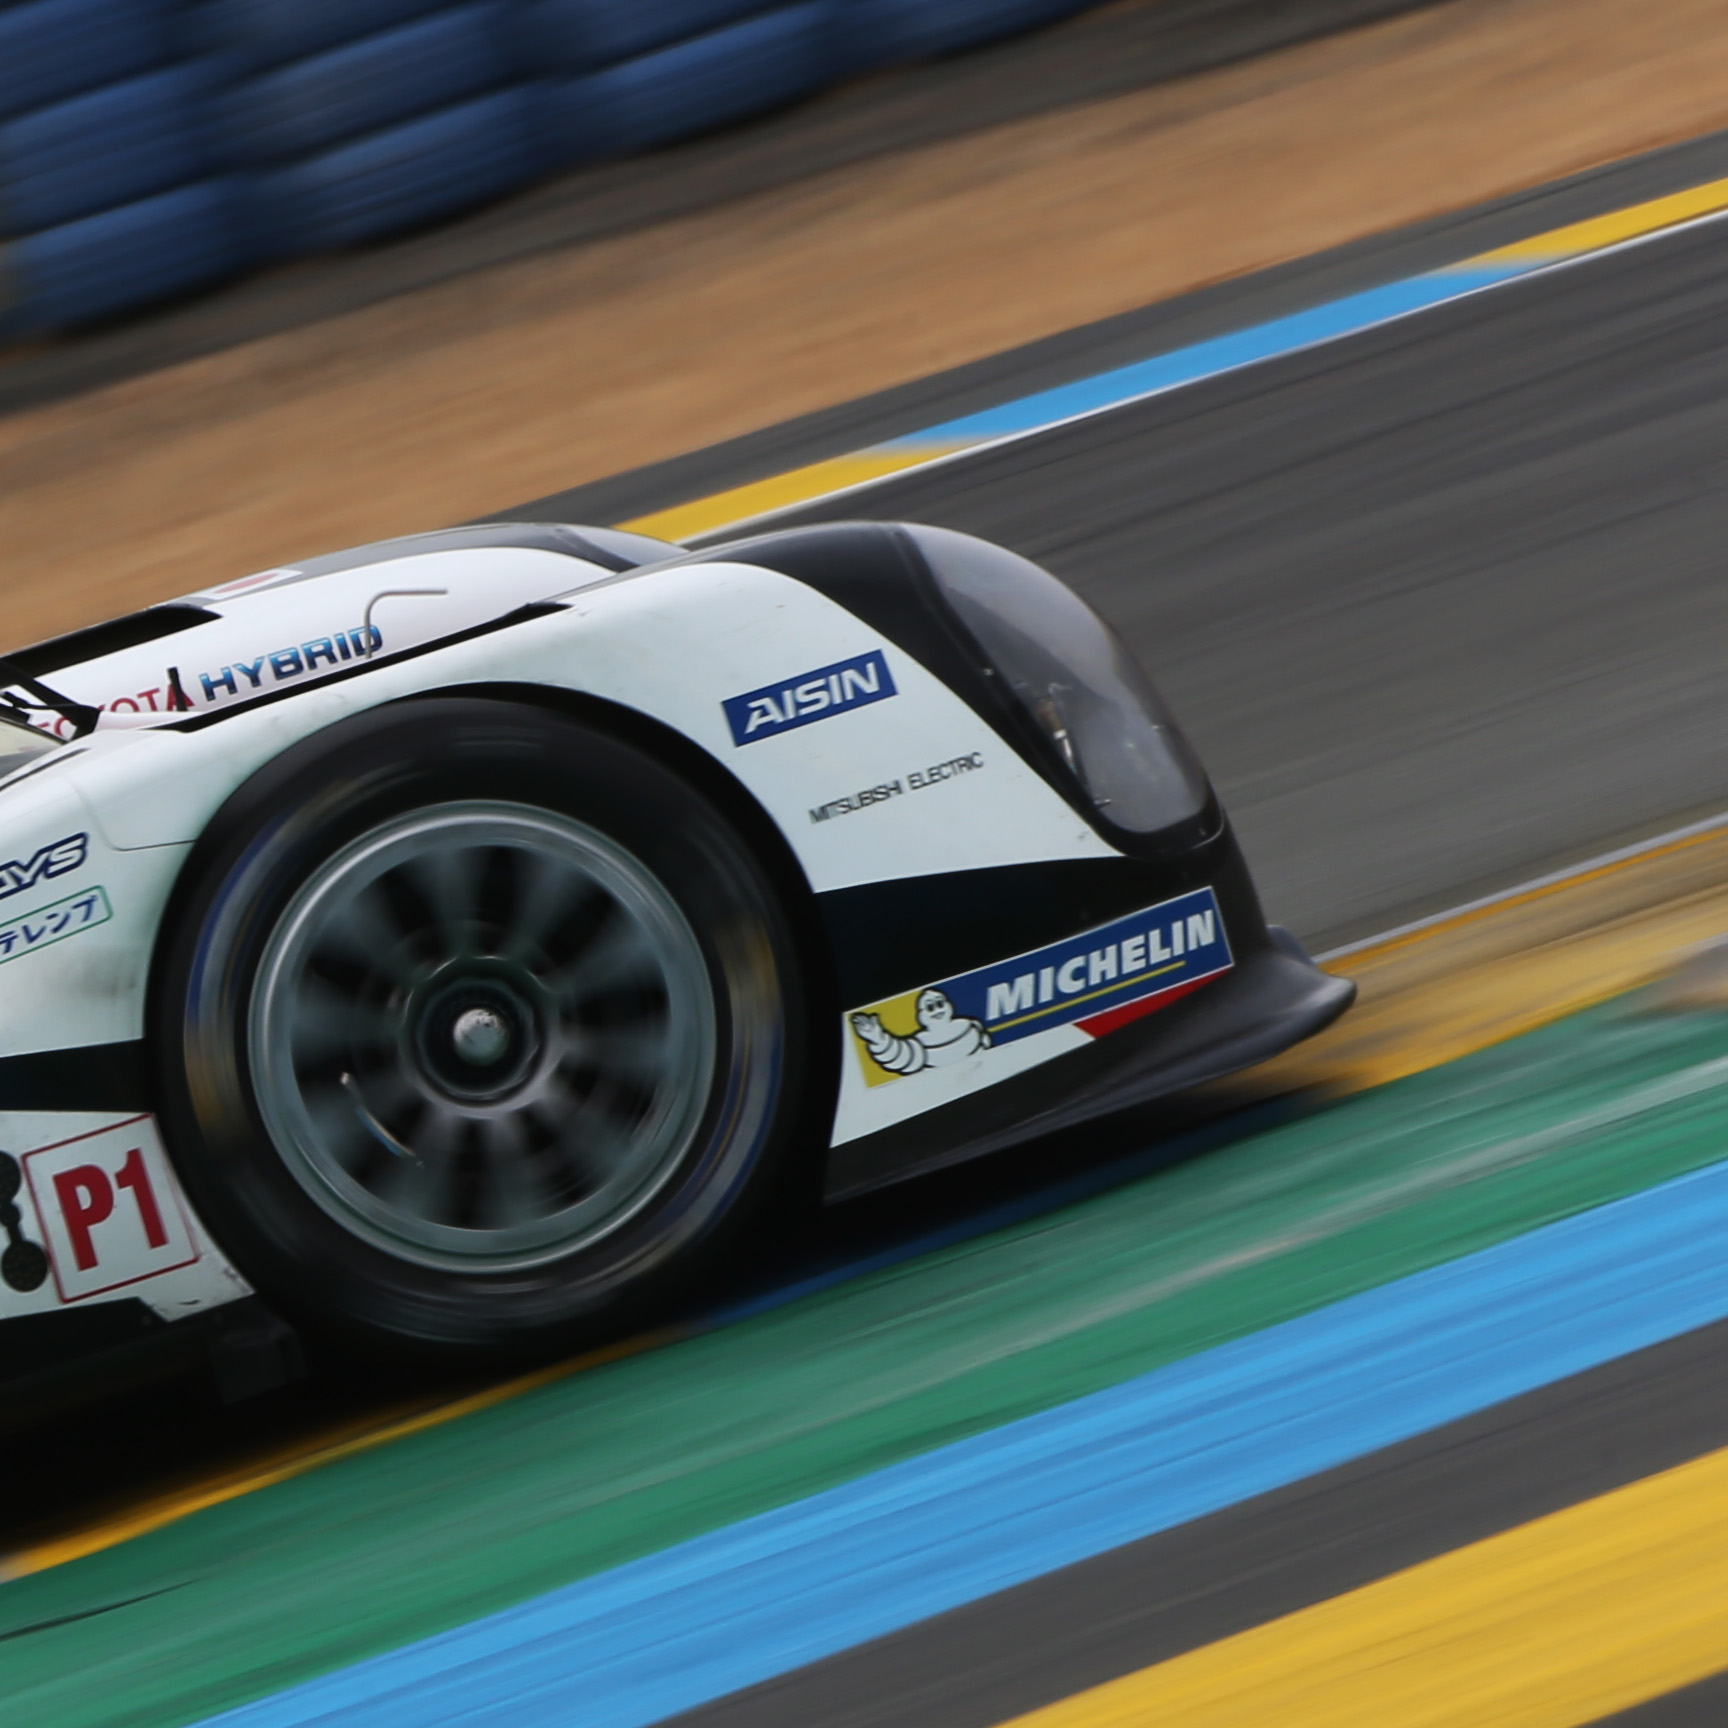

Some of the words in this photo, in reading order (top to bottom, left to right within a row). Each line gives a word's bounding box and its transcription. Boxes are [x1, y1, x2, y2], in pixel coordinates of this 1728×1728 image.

[198, 624, 383, 702] HYBRID
[744, 661, 880, 735] AISIN
[808, 780, 902, 825] MITSUBISHI
[908, 752, 984, 792] ELECTRIC
[984, 908, 1216, 1022] MICHELIN
[54, 1148, 168, 1271] P1
